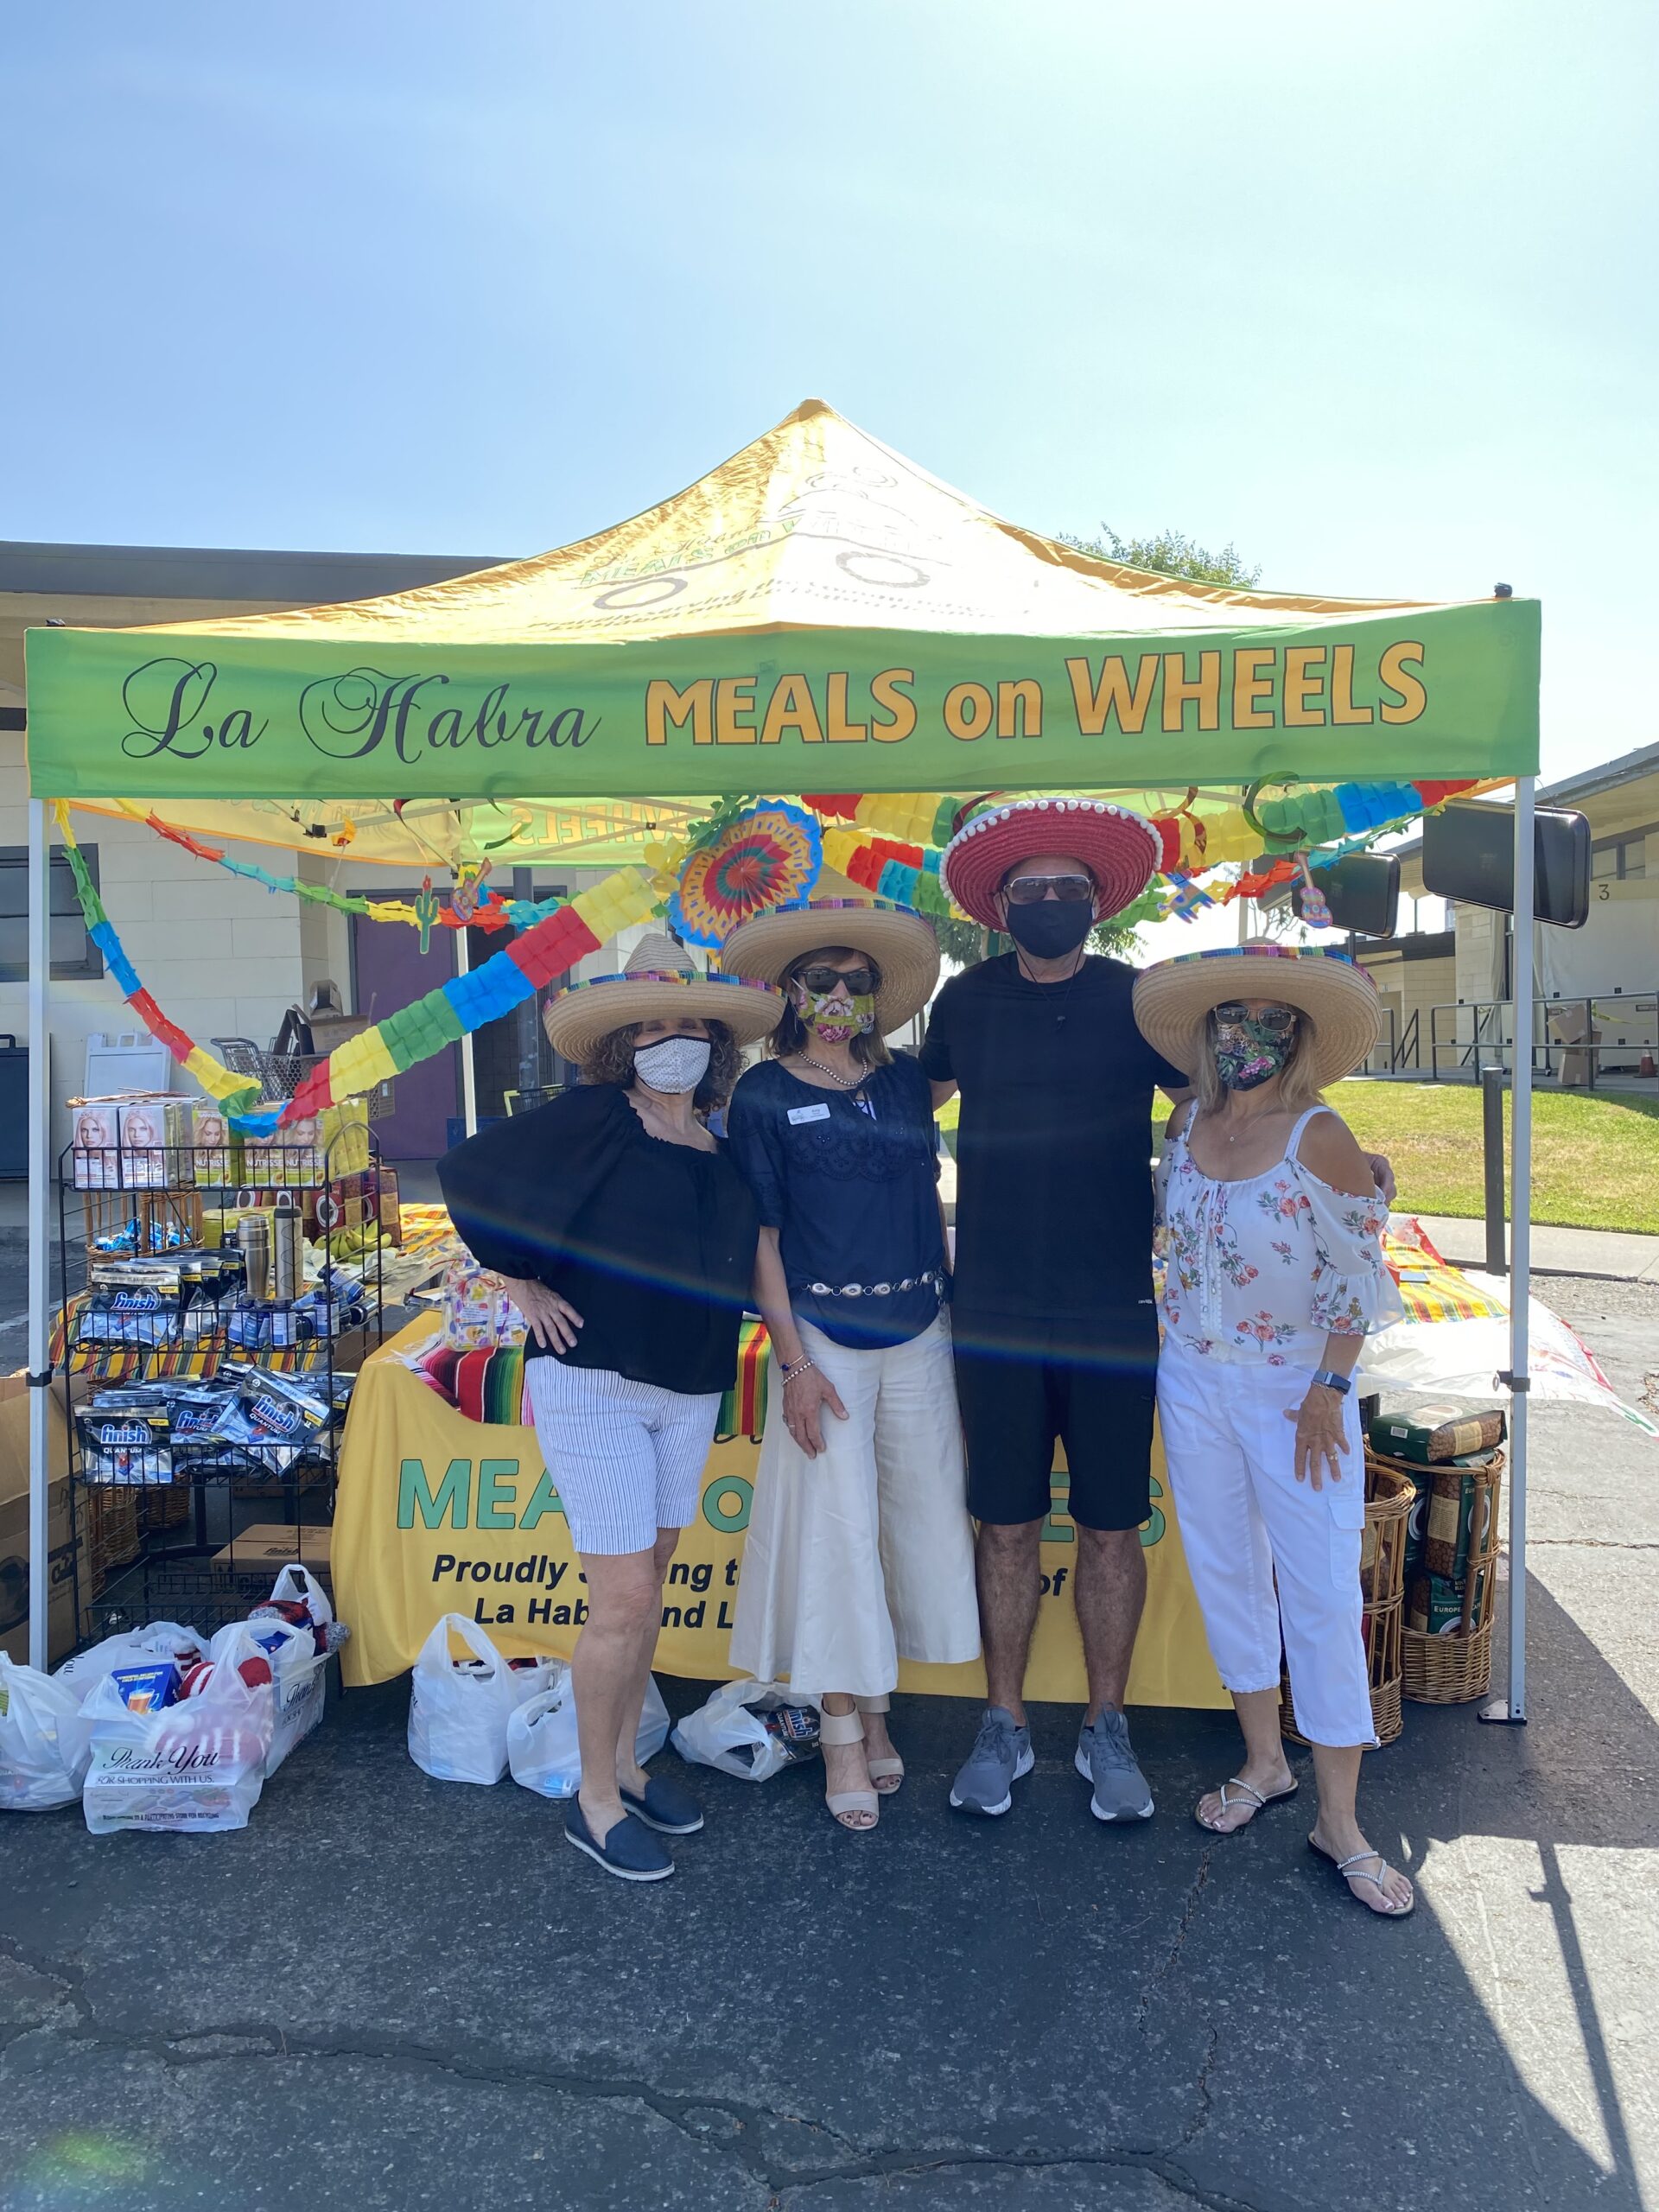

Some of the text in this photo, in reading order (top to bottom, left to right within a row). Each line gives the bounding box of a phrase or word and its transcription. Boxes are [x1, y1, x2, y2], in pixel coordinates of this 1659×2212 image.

[122, 639, 1427, 764] La Habra MEALS on WHEELS
[1599, 884, 1611, 901] 3
[112, 1292, 156, 1310] finish
[249, 1413, 281, 1434] QUANTUM
[251, 1395, 295, 1428] finish
[101, 1424, 147, 1444] finish
[397, 1459, 570, 1529] MEA
[432, 1554, 568, 1590] Proudly
[1037, 1568, 1068, 1597] of
[474, 1598, 515, 1624] La
[528, 1598, 589, 1626] Hab
[661, 1601, 704, 1629] nd
[788, 1708, 813, 1738] inish
[103, 1745, 219, 1776] Thank You
[118, 1775, 168, 1784] SHOPPING
[171, 1775, 197, 1783] WITH
[200, 1775, 215, 1783] US.
